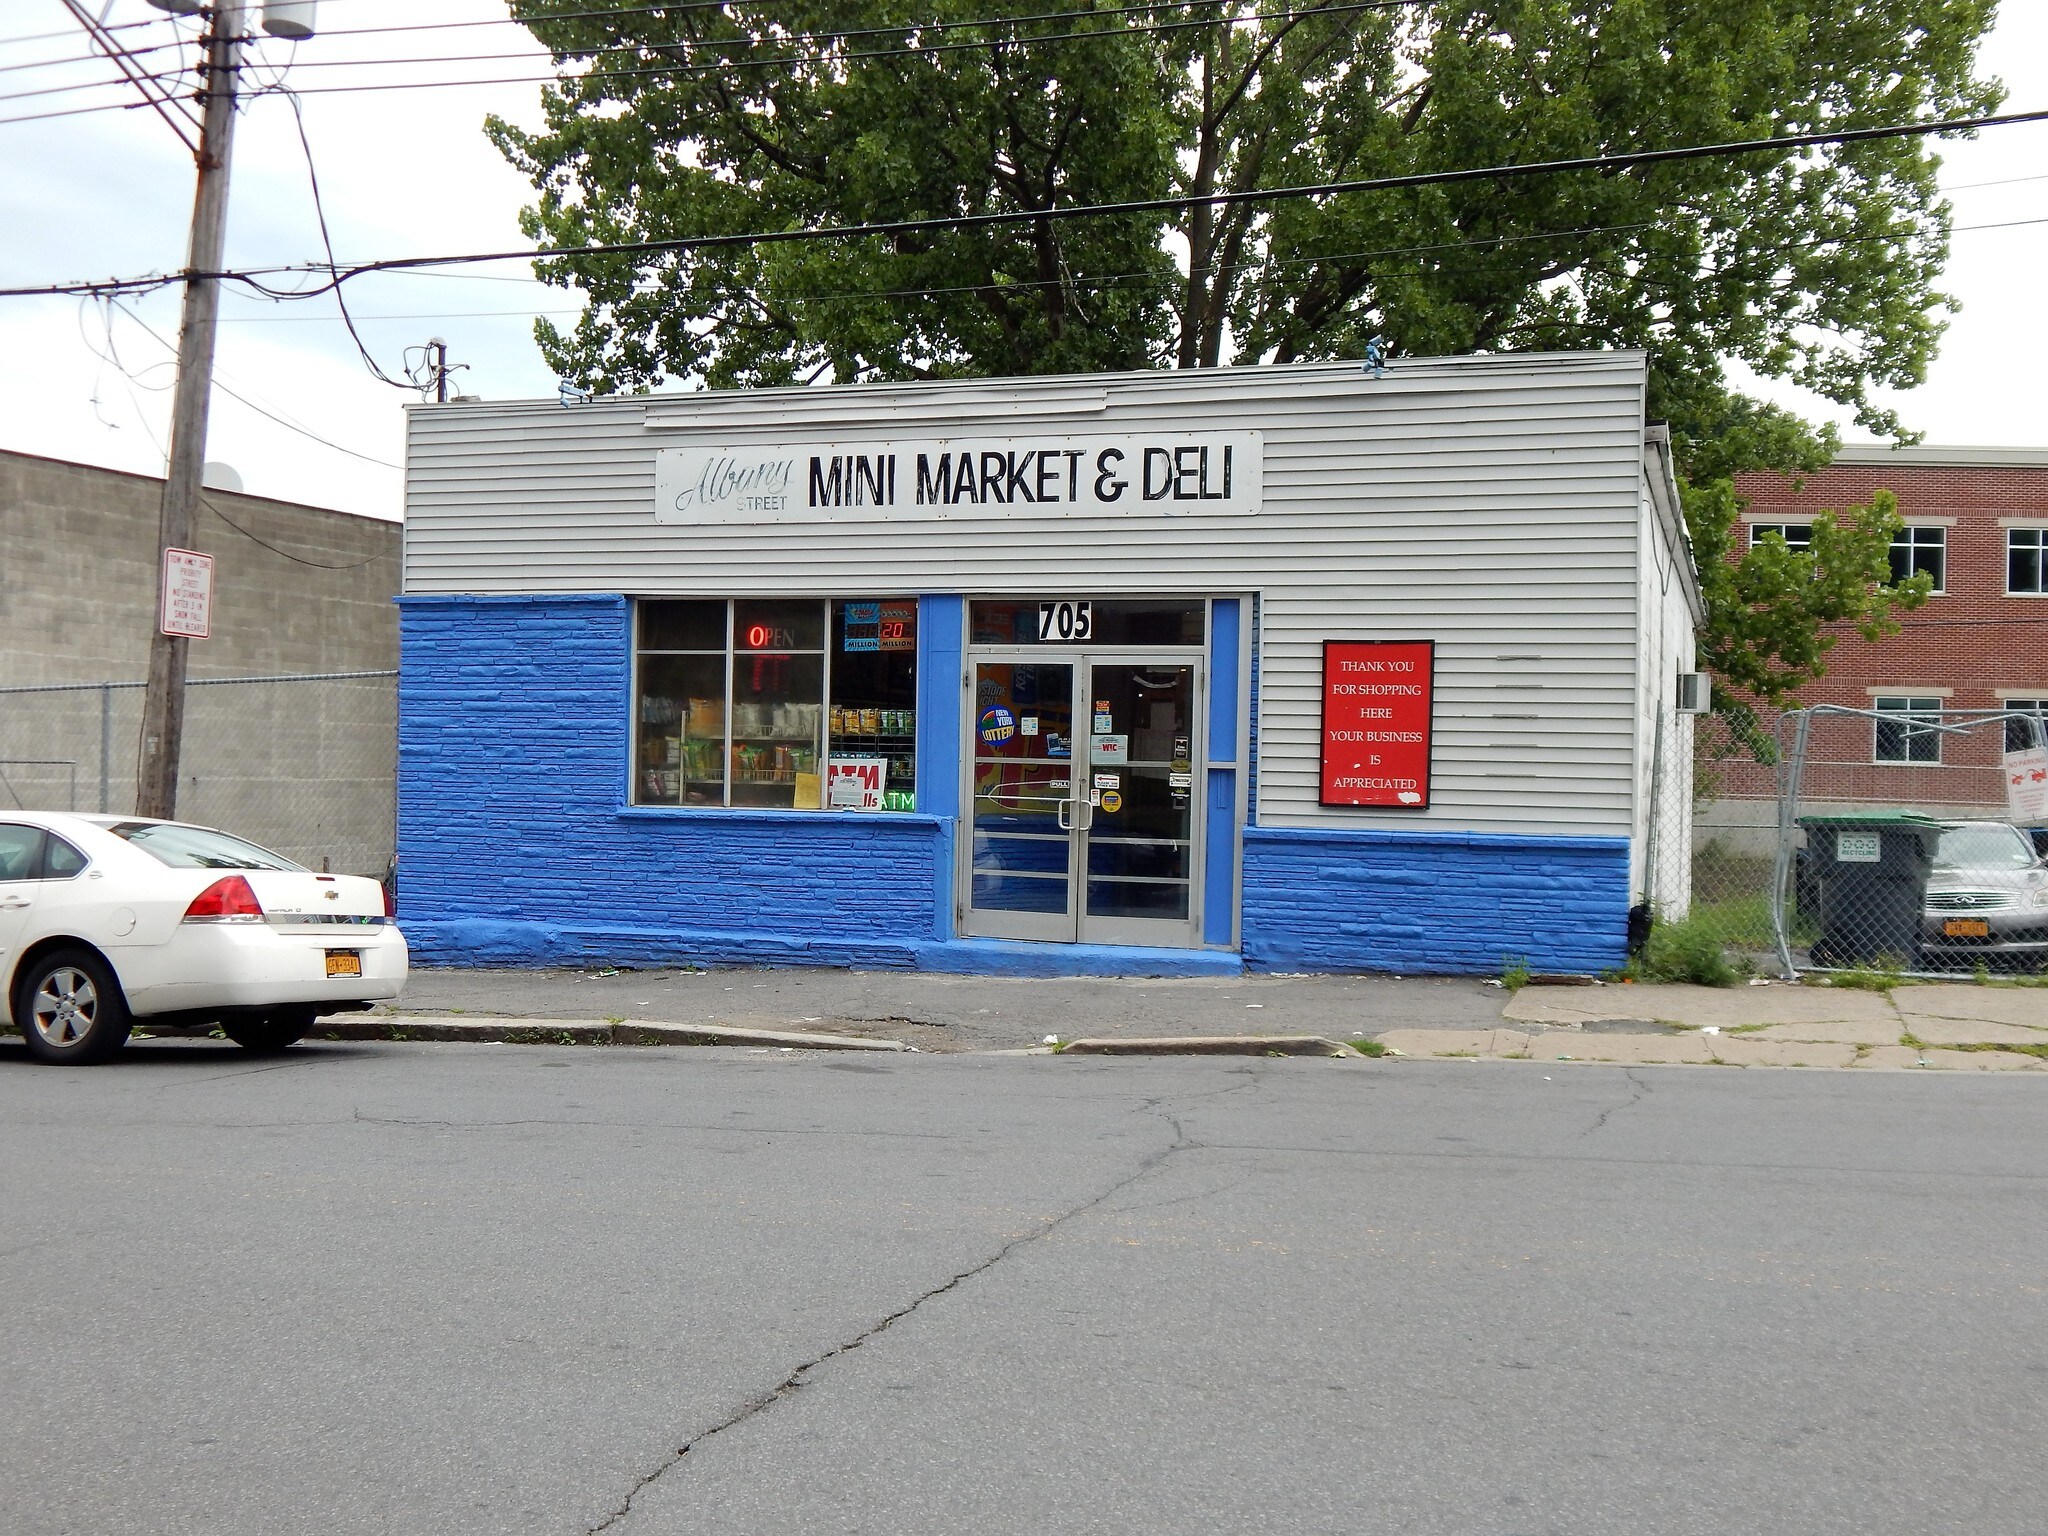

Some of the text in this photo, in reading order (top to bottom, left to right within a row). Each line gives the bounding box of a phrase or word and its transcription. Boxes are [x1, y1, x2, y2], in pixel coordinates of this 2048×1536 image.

[809, 445, 1233, 507] MINI MARKET & DELI
[736, 496, 787, 511] STREET
[1040, 602, 1090, 639] 705
[750, 626, 795, 647] OPEN
[882, 623, 904, 638] 20
[882, 640, 912, 648] MILLION
[1340, 661, 1414, 672] THANK YOU
[1333, 684, 1422, 696] FOR SHOPPING
[995, 709, 1009, 717] NEW
[1360, 708, 1393, 719] HERE
[997, 716, 1013, 727] YORK
[982, 725, 1015, 742] LOTTERY
[1330, 730, 1423, 743] YOUR BUSINESS
[1370, 754, 1381, 765] IS
[2019, 757, 2046, 767] PARKING
[1333, 777, 1417, 789] APPRECIATED
[881, 792, 915, 810] ATM
